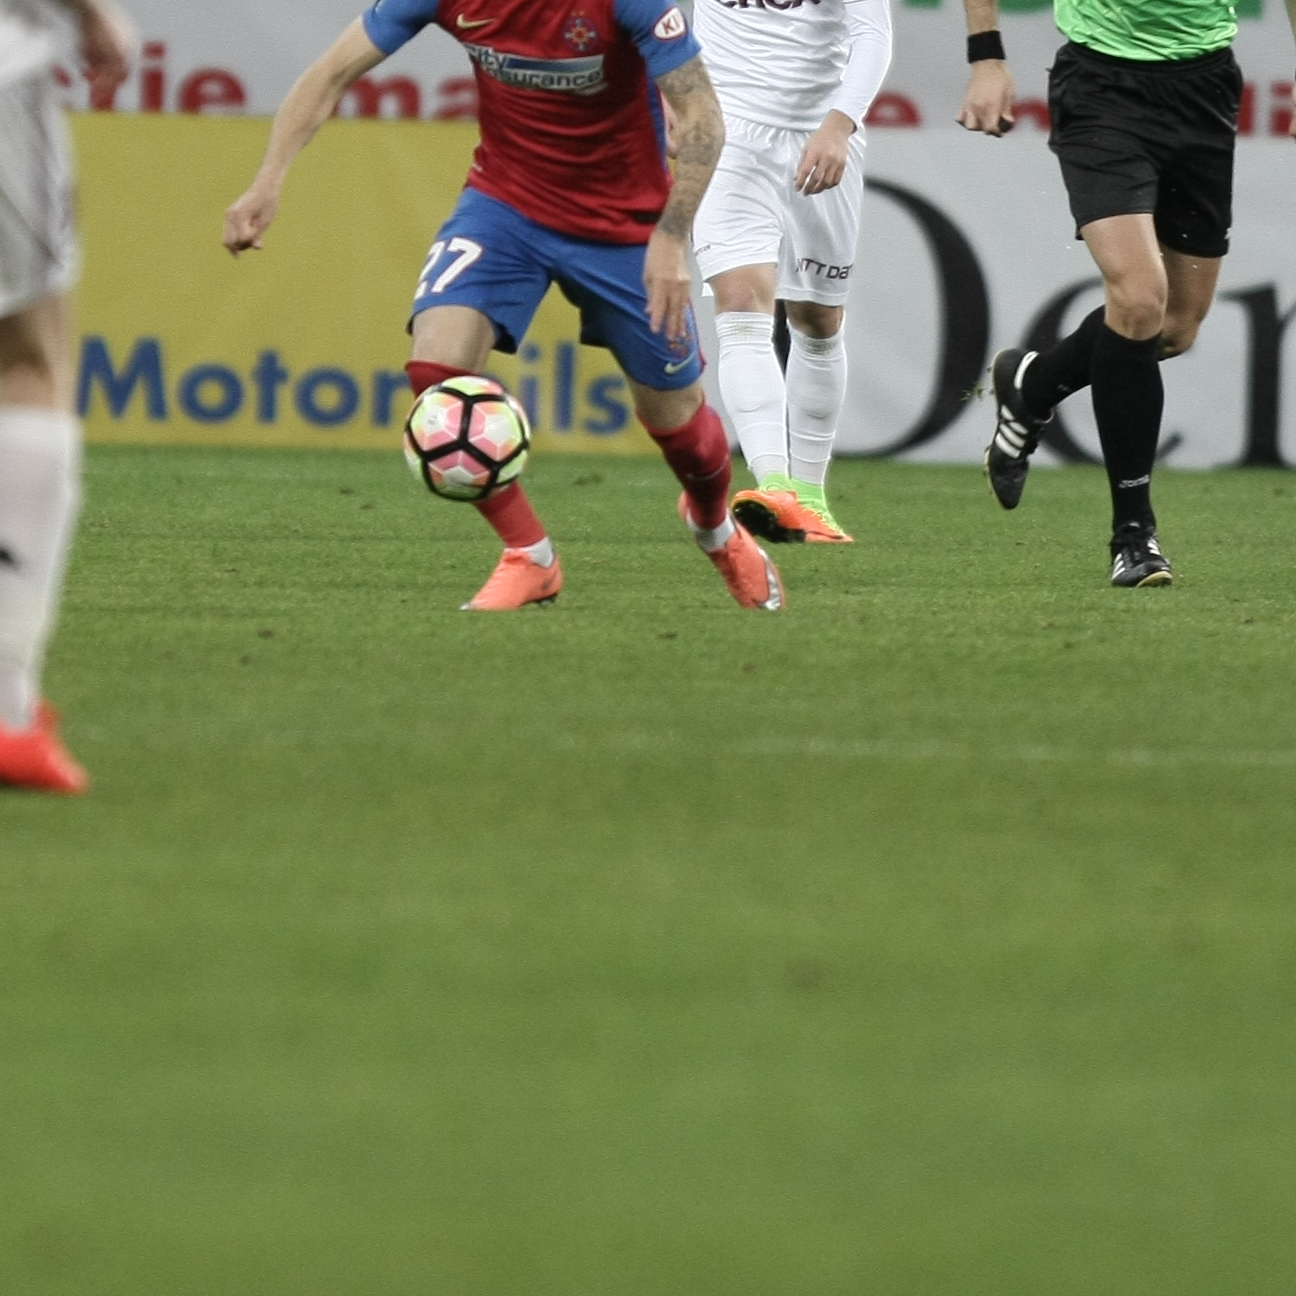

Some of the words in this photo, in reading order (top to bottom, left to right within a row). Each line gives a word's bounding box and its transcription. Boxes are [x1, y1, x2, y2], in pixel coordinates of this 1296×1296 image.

[413, 237, 483, 299] 27
[76, 335, 410, 428] Motor
[518, 340, 630, 436] ils
